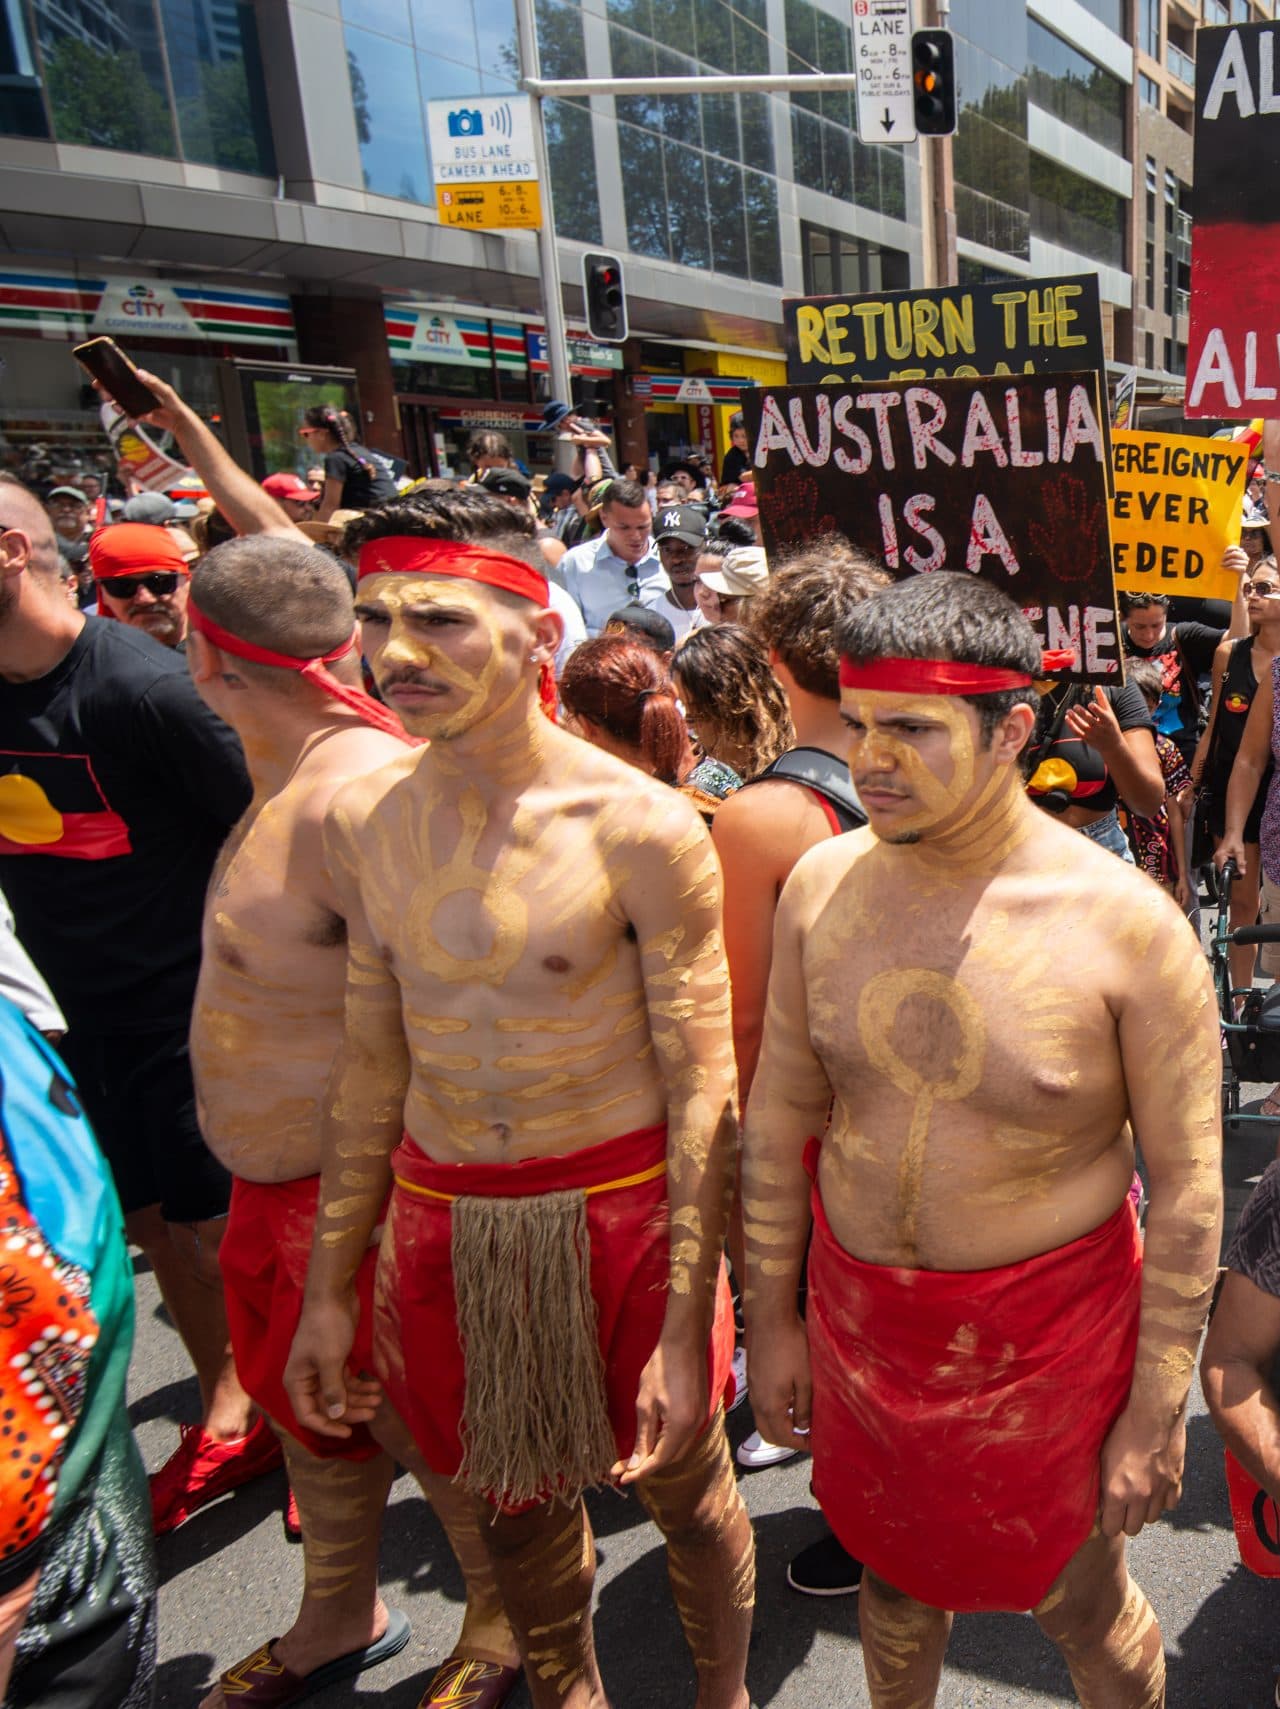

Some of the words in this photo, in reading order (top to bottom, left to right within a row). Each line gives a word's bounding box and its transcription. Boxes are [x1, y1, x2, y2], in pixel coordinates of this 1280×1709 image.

[860, 20, 904, 36] LANE
[455, 145, 477, 159] BUS
[480, 144, 511, 158] LANE
[440, 164, 486, 178] CAMERA
[492, 163, 531, 176] AHEAD
[447, 210, 484, 224] LANE
[121, 299, 166, 317] CITY
[796, 294, 976, 365] RETURN
[992, 285, 1088, 349] THE
[426, 329, 451, 345] CITY
[686, 387, 703, 396] CITY
[460, 409, 525, 421] CURRENCY
[461, 418, 526, 431] EXCHANGE
[754, 384, 1105, 475] AUSTRALIA
[1112, 442, 1244, 487] EREIGNTY
[1113, 490, 1210, 525] EVER
[878, 493, 946, 576] IS
[966, 493, 1021, 576] A
[1114, 541, 1204, 579] EDED
